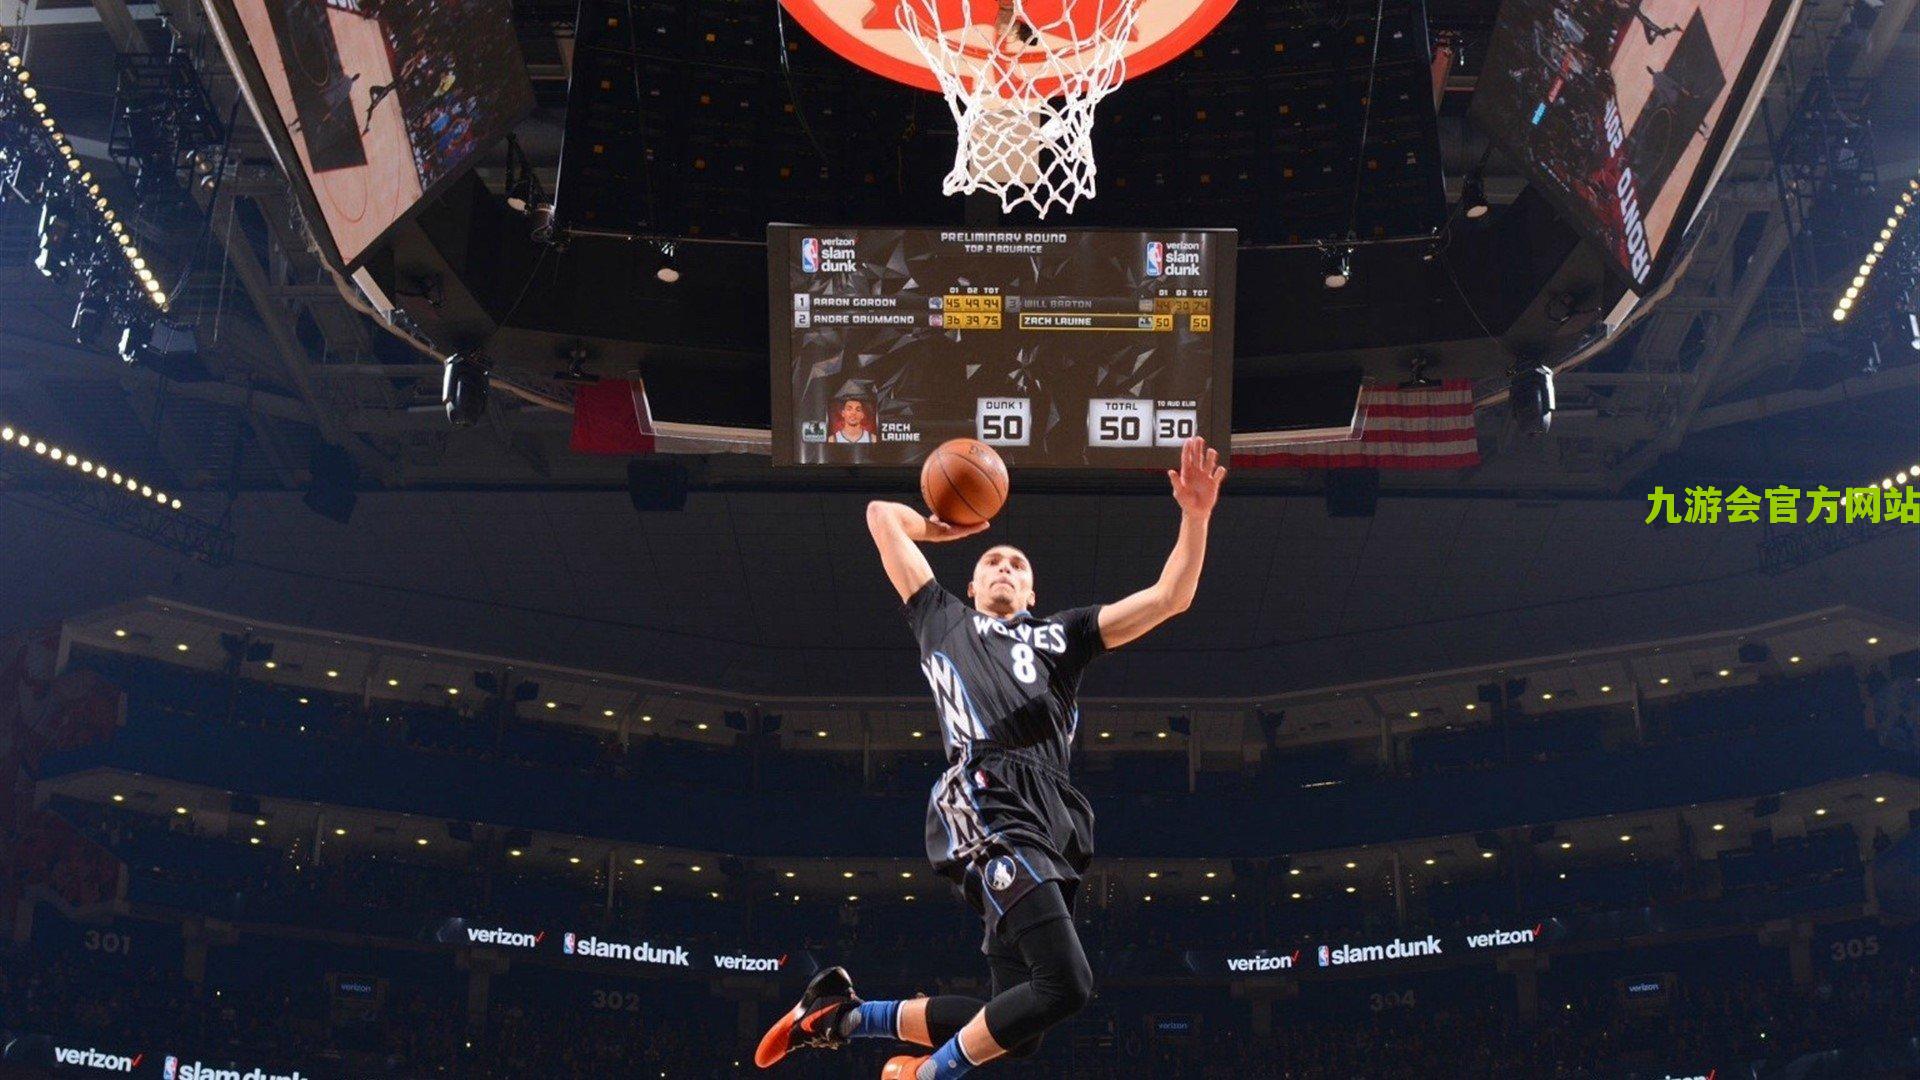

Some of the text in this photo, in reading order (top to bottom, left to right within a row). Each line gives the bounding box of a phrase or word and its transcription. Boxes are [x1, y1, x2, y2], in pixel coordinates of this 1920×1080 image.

[821, 237, 855, 246] verizon
[941, 232, 1067, 243] PRELIMINARY ROUND
[965, 245, 1042, 253] TOP 2 ADVANCE
[1165, 242, 1200, 250] verizon
[821, 247, 855, 259] slam
[1165, 251, 1199, 263] slam
[821, 260, 857, 272] dunk
[1164, 264, 1200, 276] dunk
[814, 298, 850, 307] AARON
[853, 298, 897, 307] GORDON
[946, 299, 999, 309] 45 49 94
[814, 315, 849, 324] ANDRE
[853, 315, 914, 324] DRUMMOND
[965, 316, 979, 326] 39
[984, 316, 999, 325] 75
[1024, 317, 1092, 326] ZACH LAVINE
[1156, 318, 1208, 327] 50 50
[986, 401, 1023, 410] DUNK 1
[1105, 402, 1138, 411] TOTAL
[881, 422, 911, 432] ZACH
[983, 415, 1023, 440] 50
[1100, 416, 1140, 441] 50
[1159, 418, 1193, 438] 30
[881, 432, 920, 442] LAVINE
[973, 615, 1067, 654] WOLVES
[1011, 643, 1037, 684] 8
[85, 930, 131, 954] 301
[467, 927, 536, 947] verizon
[1466, 928, 1534, 948] verizon
[577, 936, 689, 966] slam dunk
[1332, 935, 1442, 966] slam dunk
[714, 954, 779, 972] verizon
[1227, 954, 1292, 972] verizon
[1628, 982, 1660, 992] verizon
[592, 989, 640, 1012] 302
[55, 1046, 132, 1073] verizon
